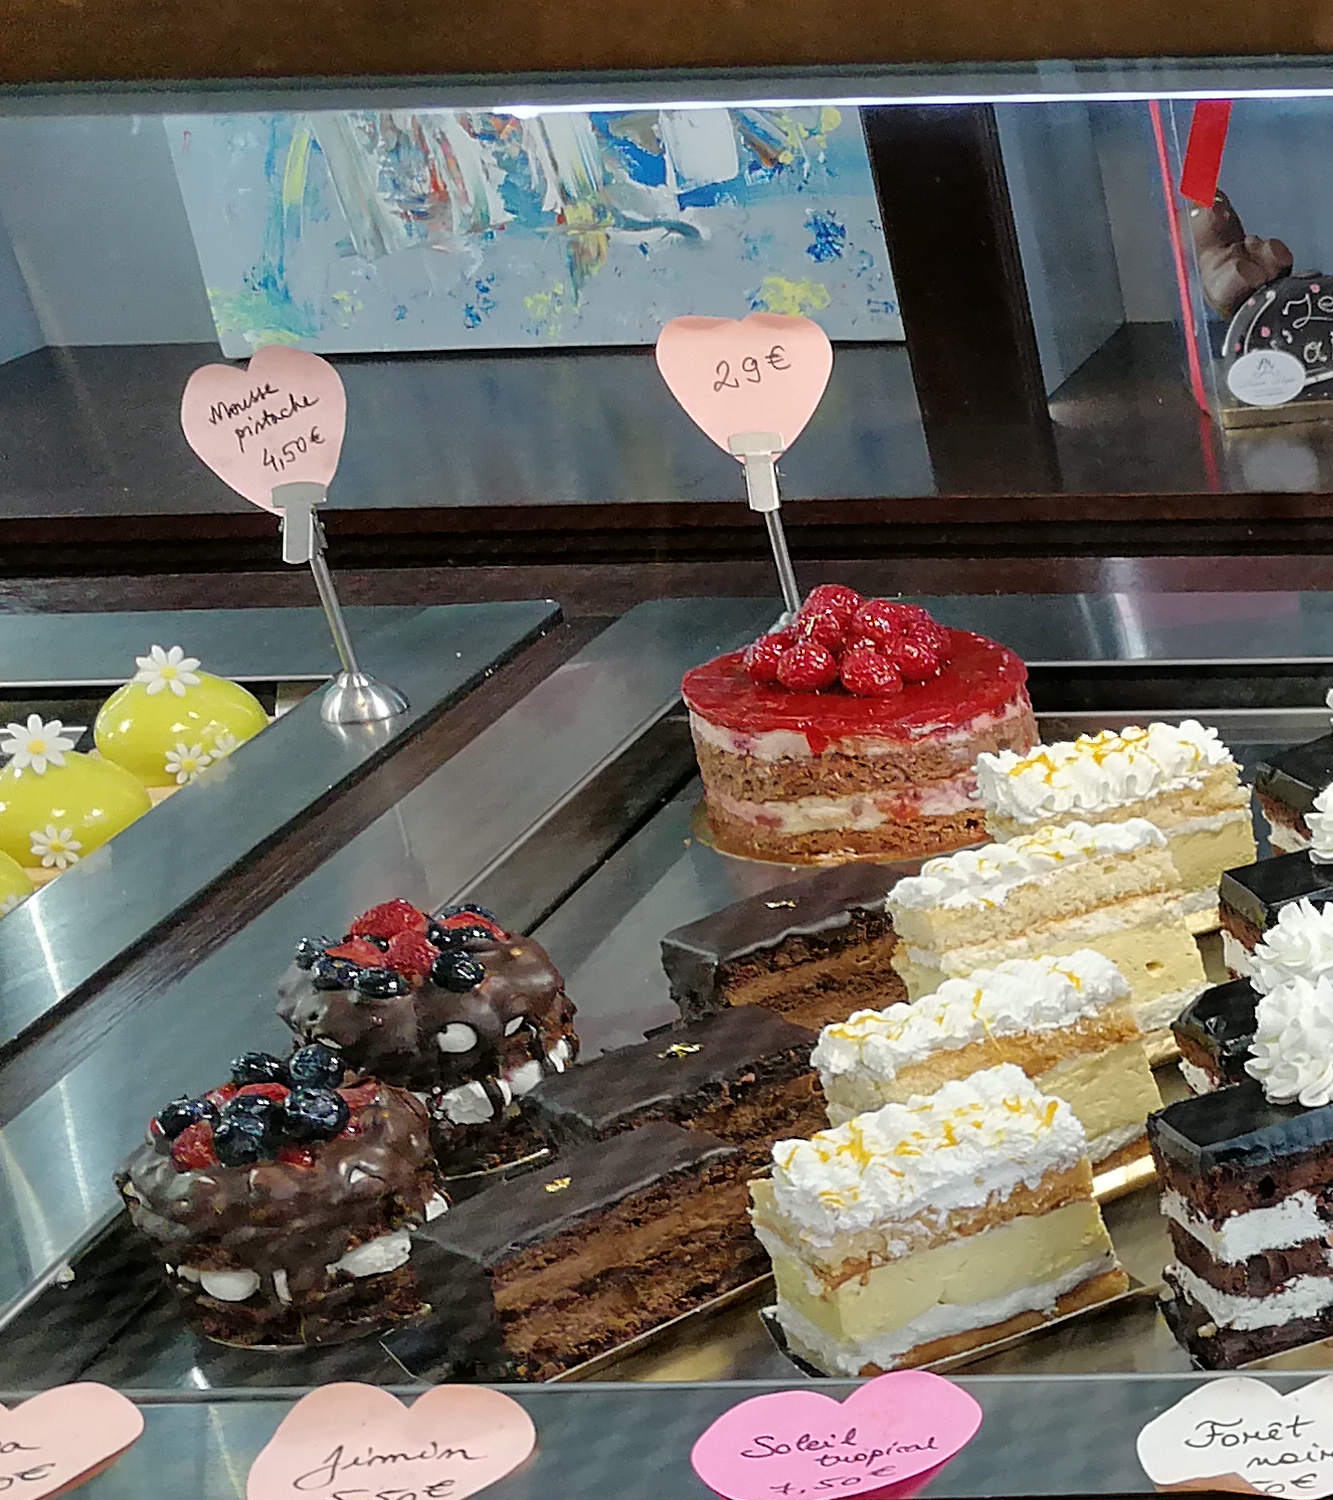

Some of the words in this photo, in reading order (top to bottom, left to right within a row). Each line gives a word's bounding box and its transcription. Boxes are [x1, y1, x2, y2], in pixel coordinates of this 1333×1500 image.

[713, 345, 791, 393] 29€
[209, 383, 279, 425] Mousse
[234, 393, 319, 453] pistache
[262, 426, 325, 472] 4,50€
[740, 1427, 859, 1459] Soleil
[1184, 1414, 1314, 1449] Forêt
